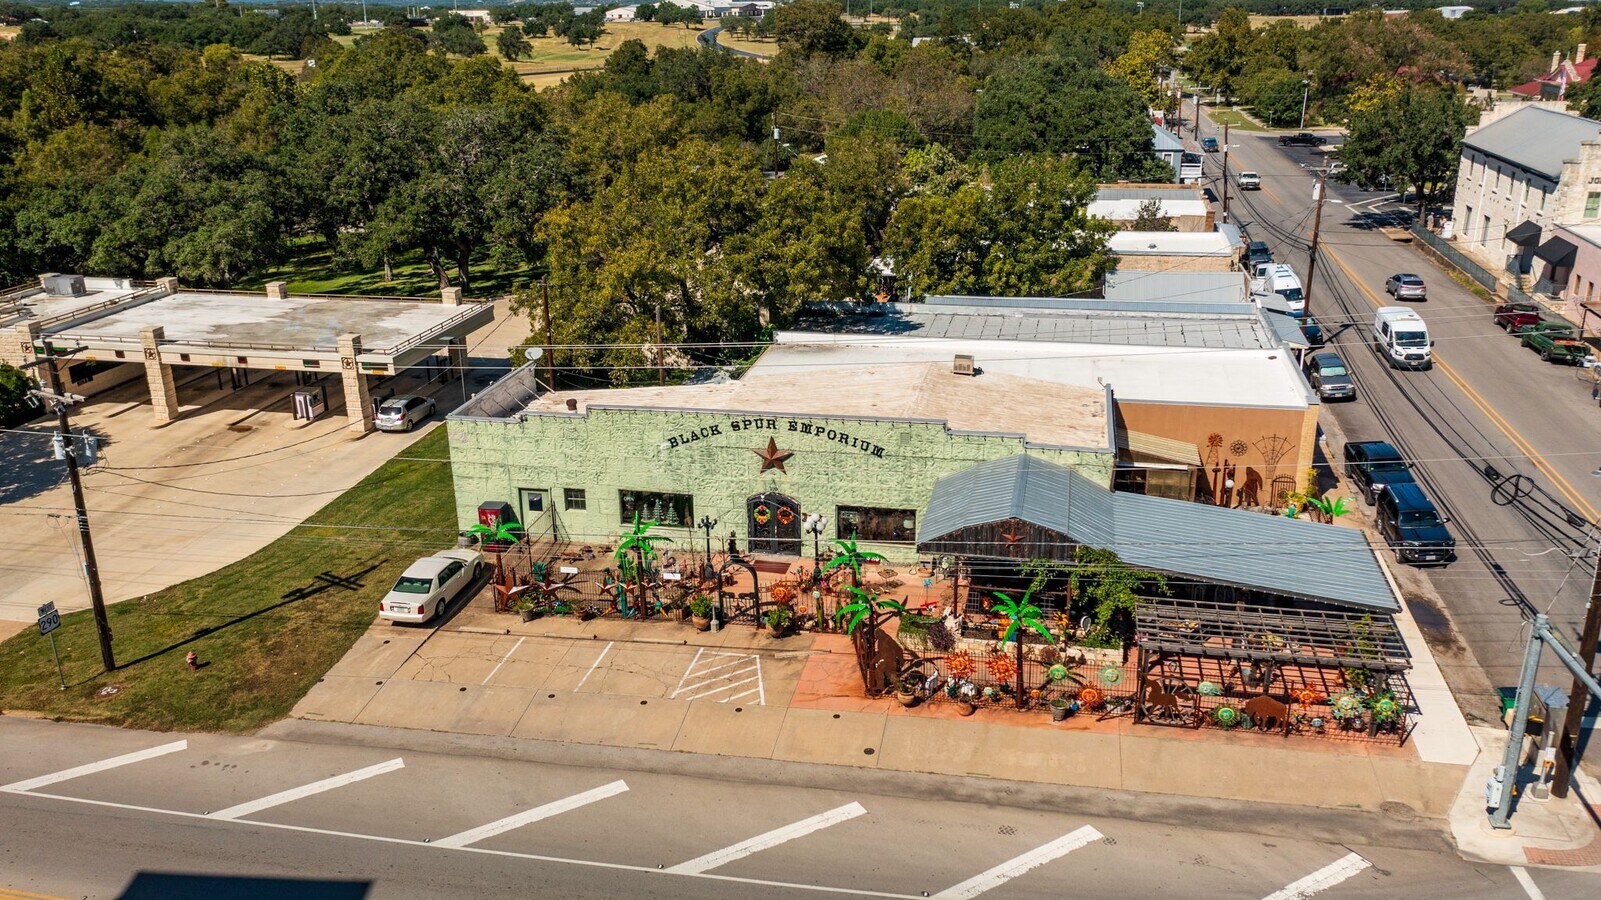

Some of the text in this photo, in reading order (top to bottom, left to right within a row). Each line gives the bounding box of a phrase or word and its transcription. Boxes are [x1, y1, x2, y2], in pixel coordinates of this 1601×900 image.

[667, 418, 886, 459] BLACK SPUR EMPORIUM
[41, 615, 58, 630] 290
